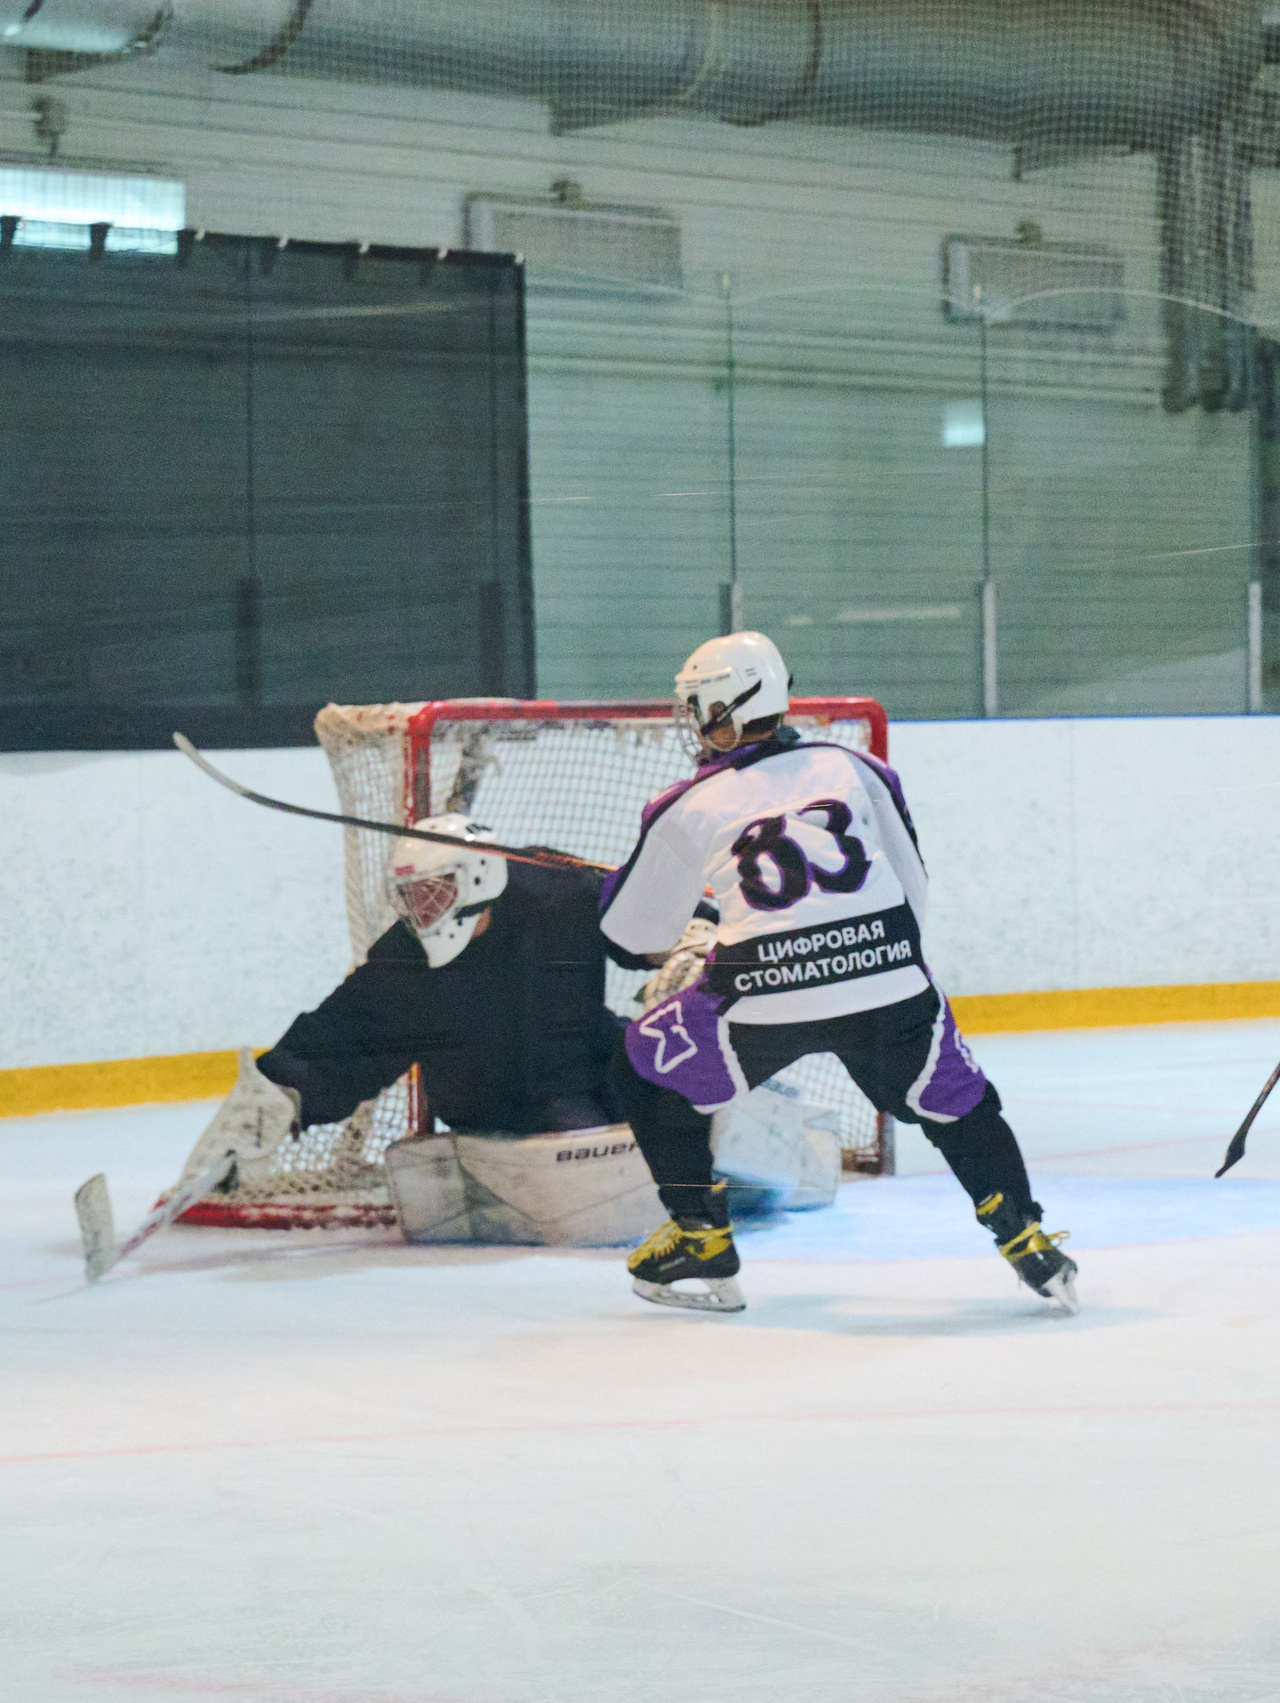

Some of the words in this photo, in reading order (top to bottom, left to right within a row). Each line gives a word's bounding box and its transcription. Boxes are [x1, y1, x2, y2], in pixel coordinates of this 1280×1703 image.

[731, 799, 872, 912] 83
[734, 940, 912, 991] СТОМАТОЛОГИЯ
[757, 920, 885, 963] ЦИФРОВАЯ
